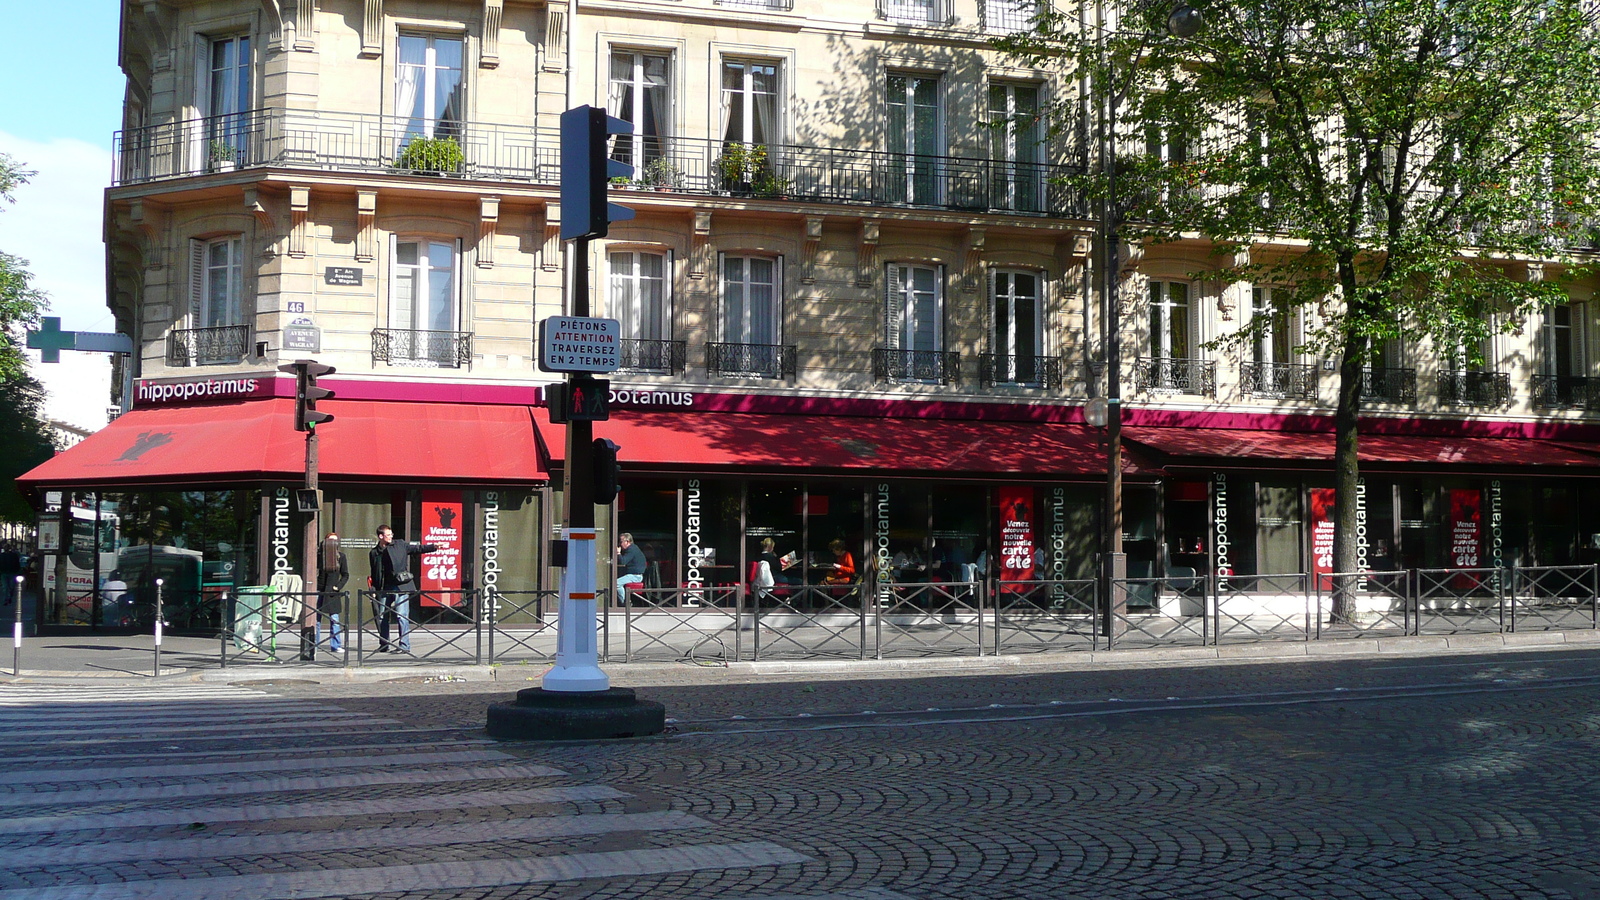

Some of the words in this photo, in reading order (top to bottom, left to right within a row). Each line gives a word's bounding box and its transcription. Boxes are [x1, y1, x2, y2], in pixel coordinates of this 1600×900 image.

[289, 302, 302, 312] 46
[561, 320, 607, 331] PIÉTONS
[554, 332, 613, 343] ATTENTION
[552, 344, 615, 355] TRAVERSEZ
[551, 356, 564, 364] EN
[568, 356, 575, 364] 2
[579, 356, 615, 366] TEMPS
[139, 378, 255, 402] hippopotamus
[682, 479, 704, 608] hippopotamus
[1050, 488, 1069, 609] hippopotamus
[1453, 545, 1476, 553] carte
[1002, 546, 1029, 555] carte
[1314, 546, 1333, 555] cart
[424, 555, 455, 564] carte
[1006, 555, 1031, 569] été
[1318, 554, 1333, 567] ét
[1456, 553, 1478, 566] été
[428, 564, 458, 580] été
